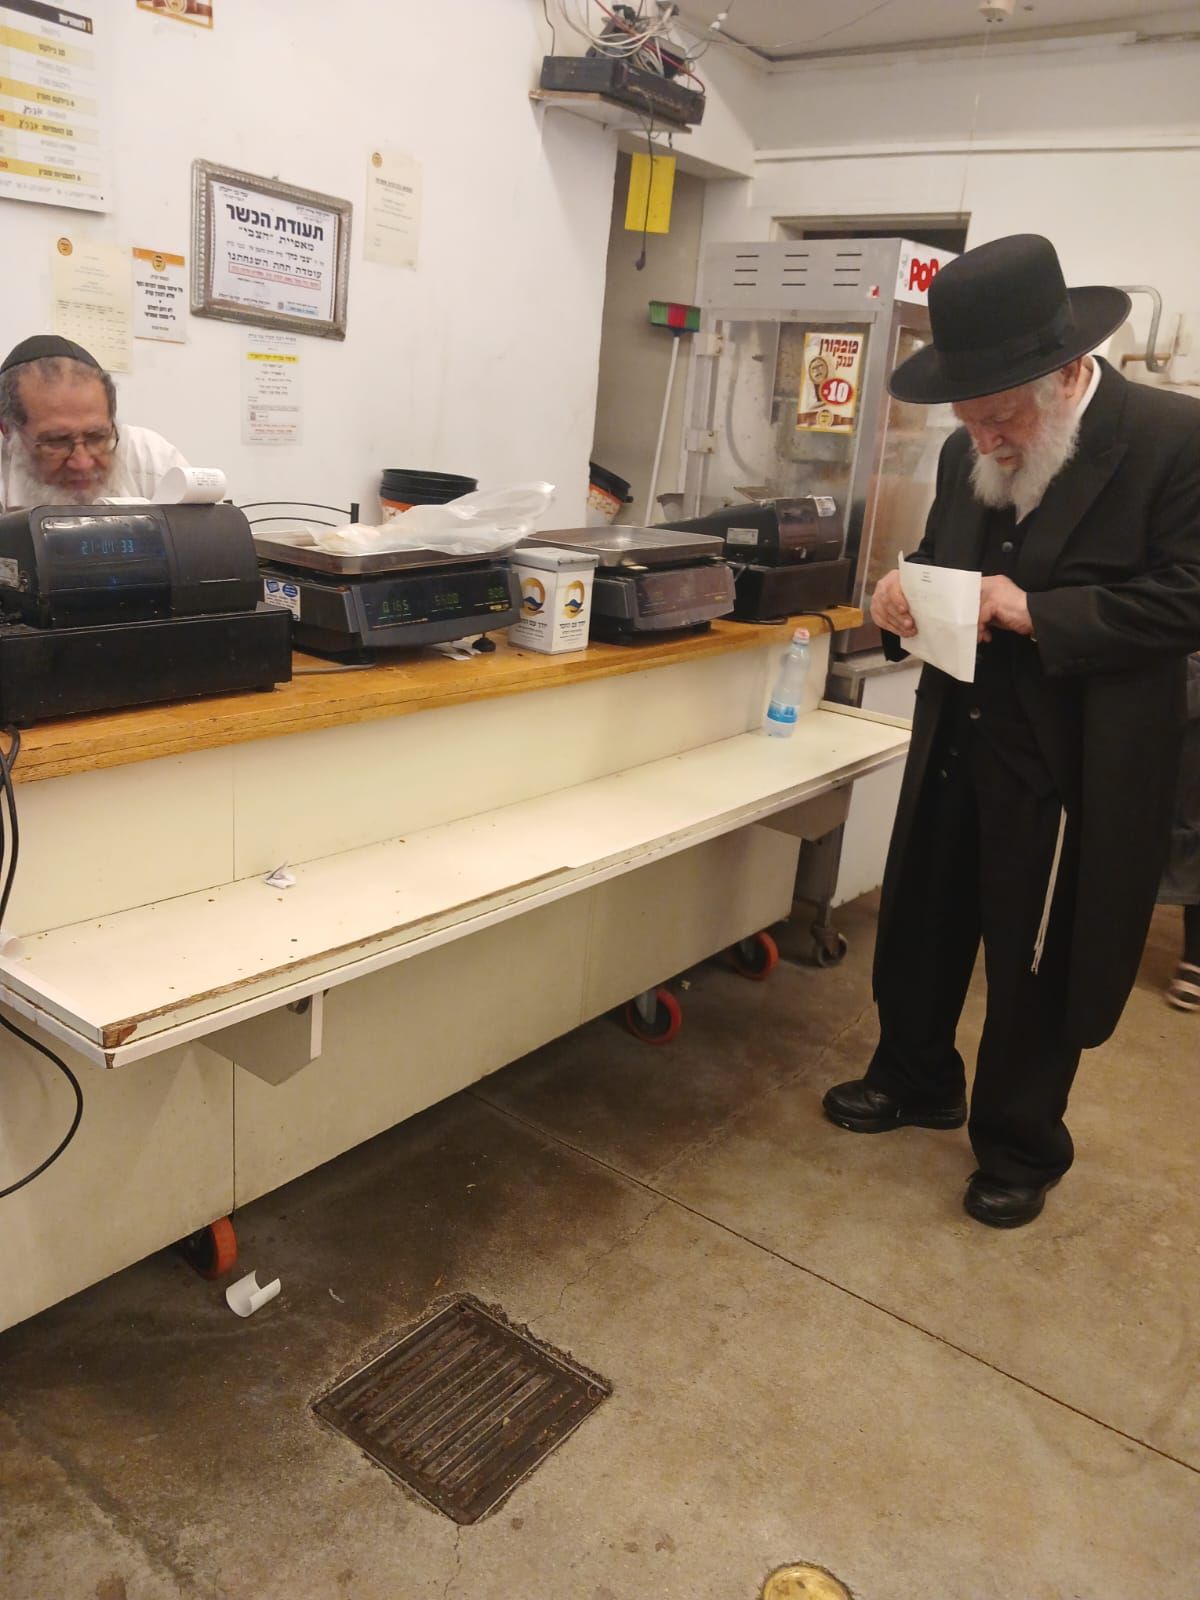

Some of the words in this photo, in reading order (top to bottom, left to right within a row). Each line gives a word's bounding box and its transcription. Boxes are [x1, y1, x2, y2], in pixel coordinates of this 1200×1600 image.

[226, 203, 271, 229] הכשר
[274, 215, 324, 241] תעודת
[278, 235, 315, 251] מאפיית
[272, 261, 292, 272] תחת
[819, 338, 859, 356] פופקורן
[836, 355, 854, 371] ענק
[827, 380, 849, 403] 10
